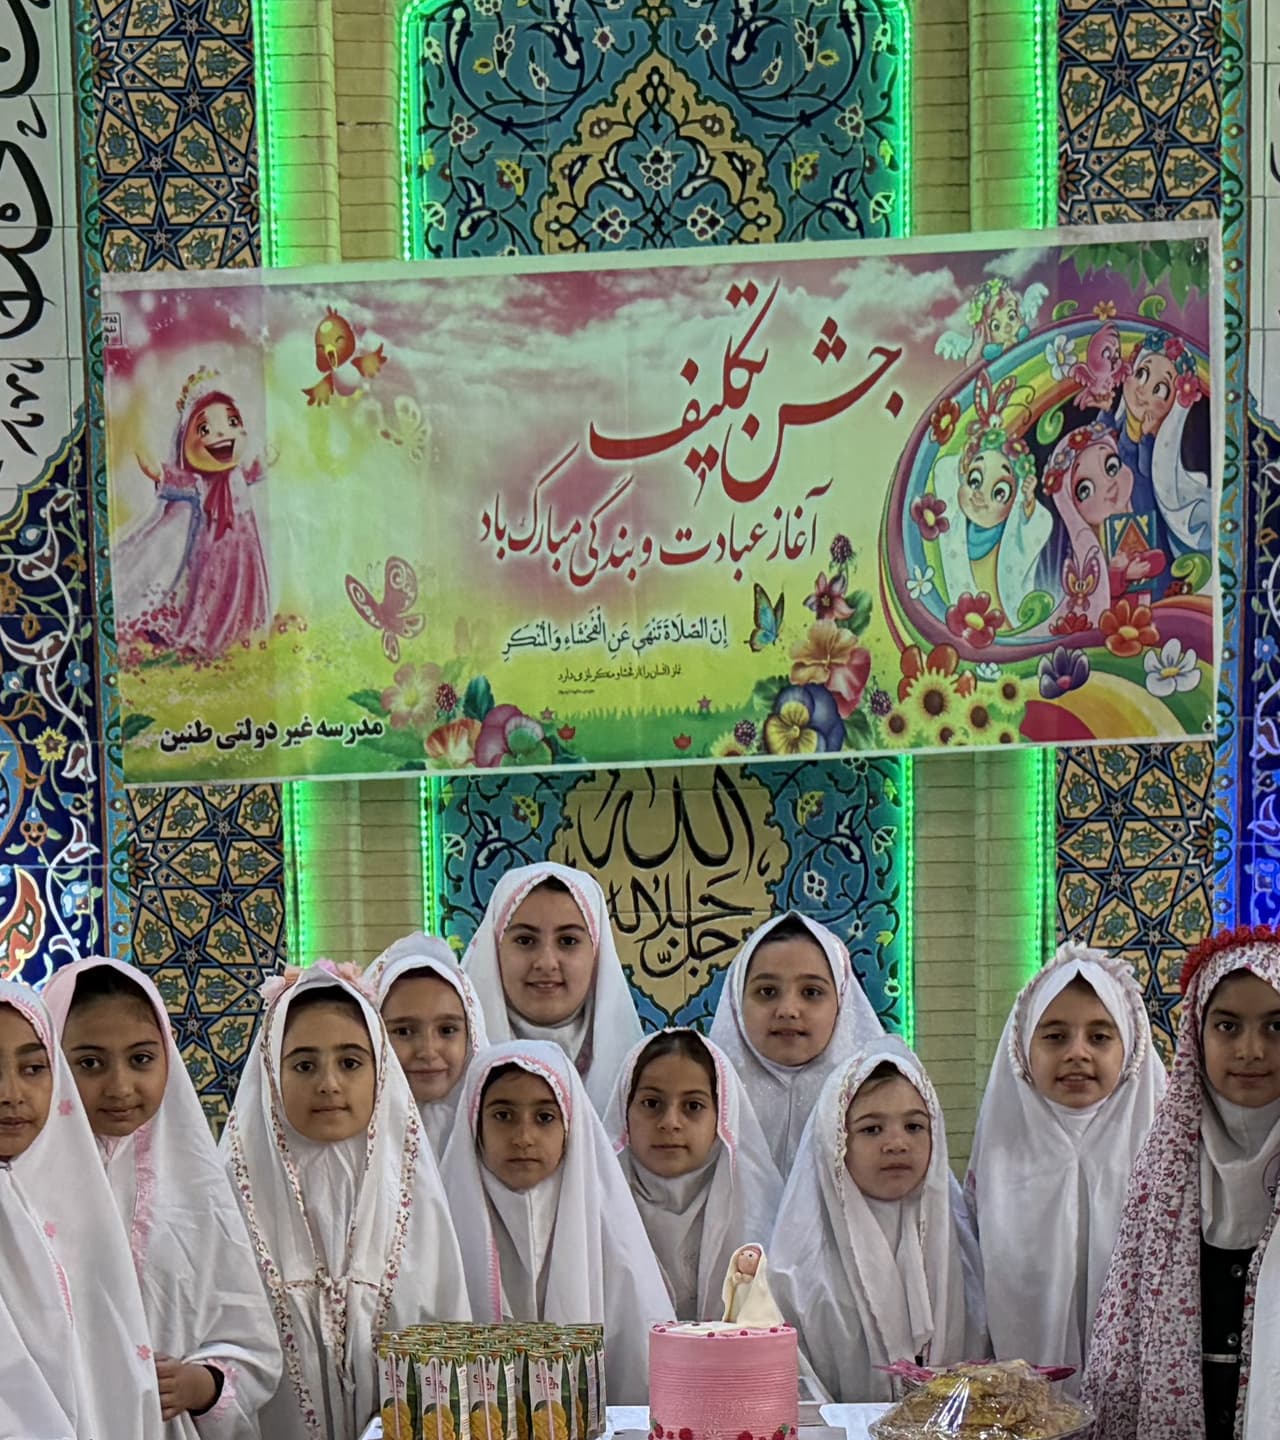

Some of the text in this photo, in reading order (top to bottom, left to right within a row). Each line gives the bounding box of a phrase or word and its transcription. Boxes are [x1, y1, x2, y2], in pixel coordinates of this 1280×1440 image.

[588, 276, 904, 503] جشن تکلیف
[480, 493, 507, 560] باد
[507, 442, 582, 572] مبارک
[569, 473, 634, 587] بندگی
[659, 513, 768, 582] عبادت
[767, 477, 833, 561] آغاز
[160, 716, 383, 752] مدرسه غیر دولتی طنین
